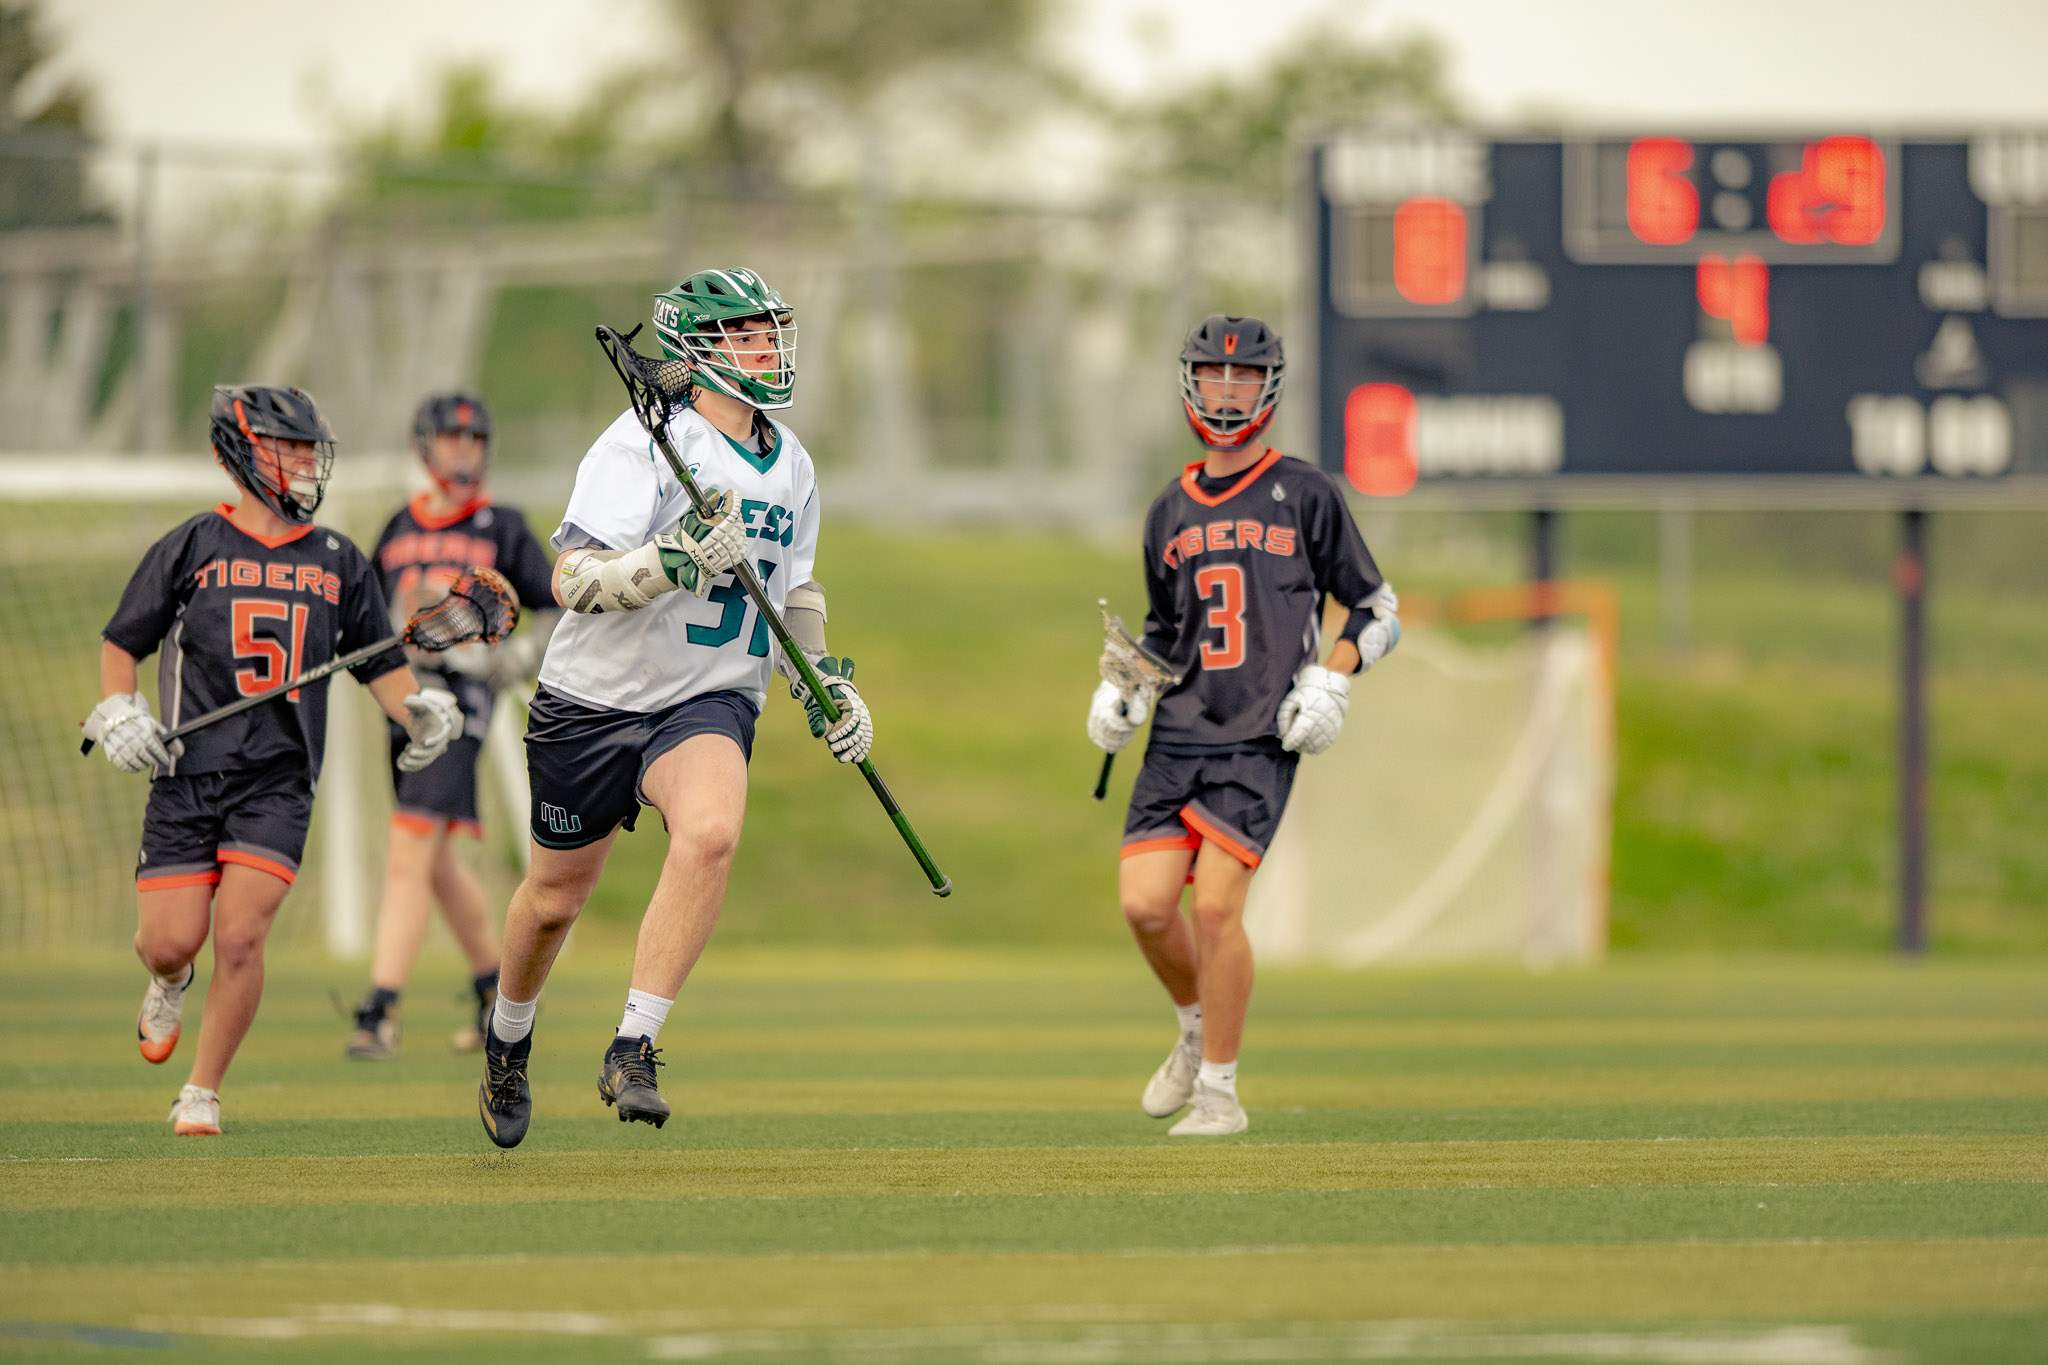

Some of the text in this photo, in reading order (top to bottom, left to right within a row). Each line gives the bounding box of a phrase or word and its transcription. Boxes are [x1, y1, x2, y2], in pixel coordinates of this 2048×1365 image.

[654, 298, 680, 328] CATS
[740, 498, 794, 548] EST
[1163, 519, 1295, 570] TIGERS
[195, 558, 341, 606] TIGERS
[1195, 563, 1245, 671] 3
[231, 598, 309, 703] 51
